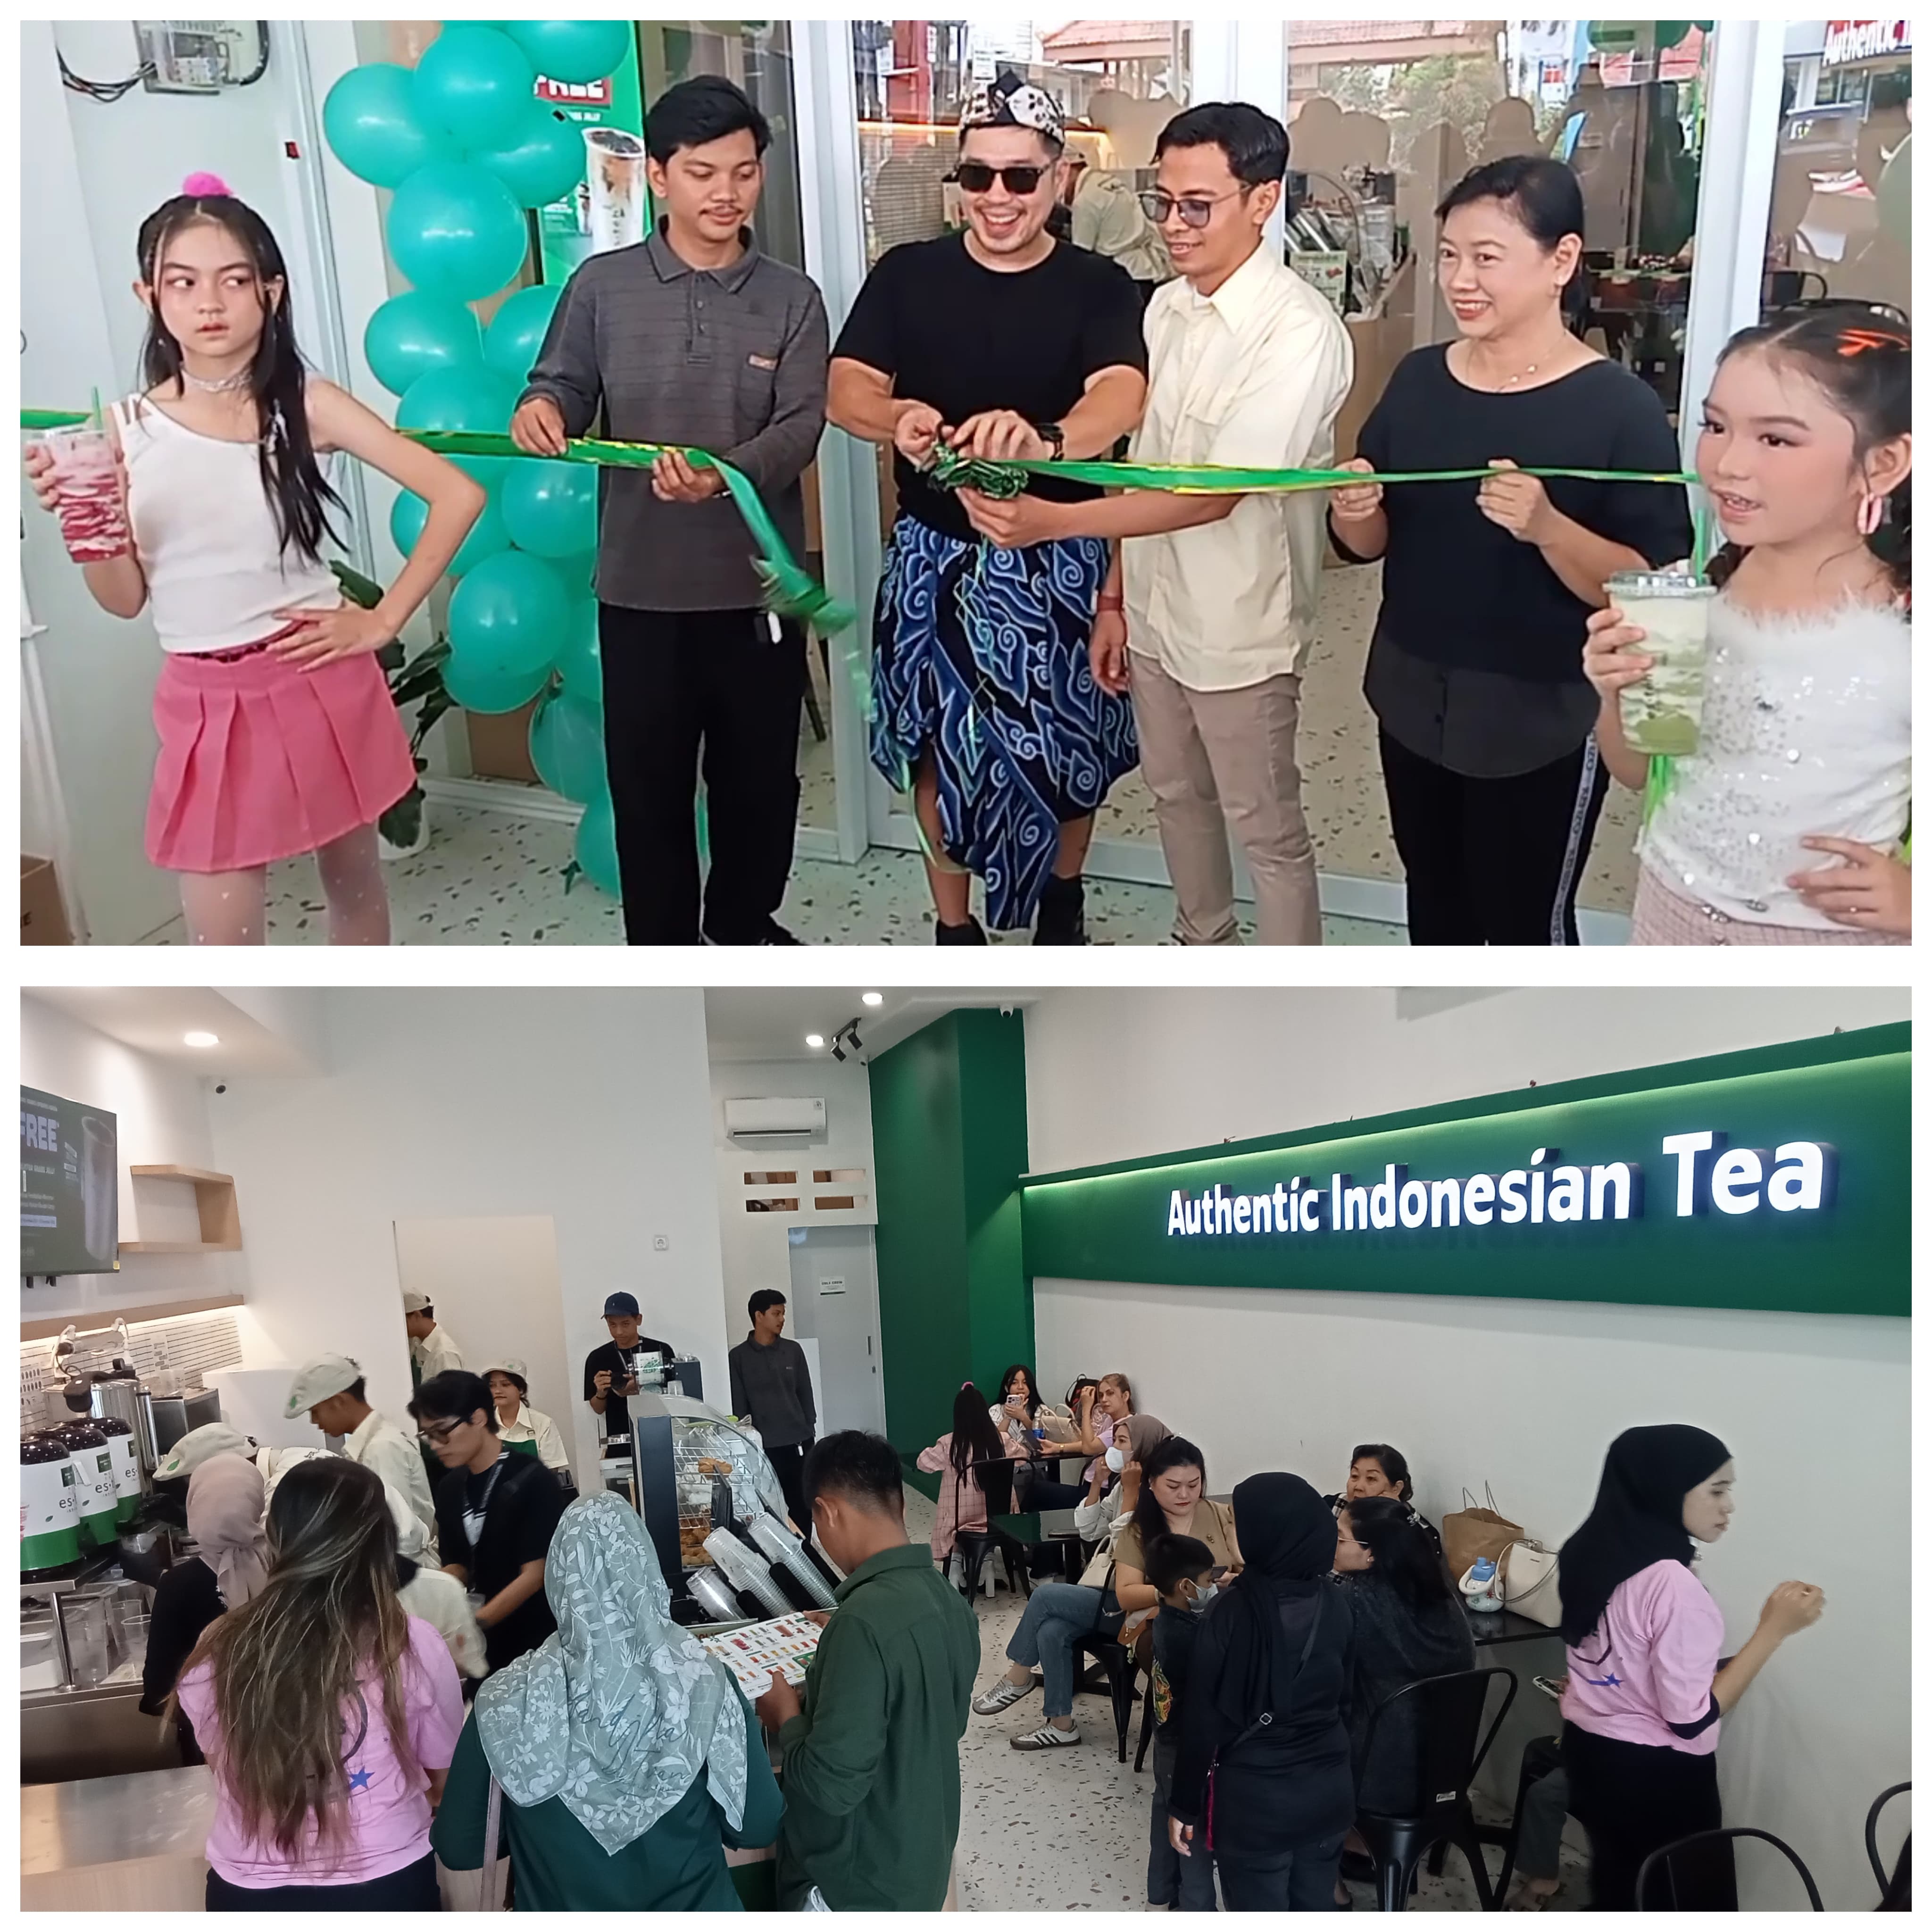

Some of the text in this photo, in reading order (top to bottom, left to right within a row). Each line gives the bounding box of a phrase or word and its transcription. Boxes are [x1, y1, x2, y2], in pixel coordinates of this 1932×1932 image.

[1822, 20, 1898, 67] Authentic
[1168, 1131, 1824, 1236] Authentic Indonesian Tea
